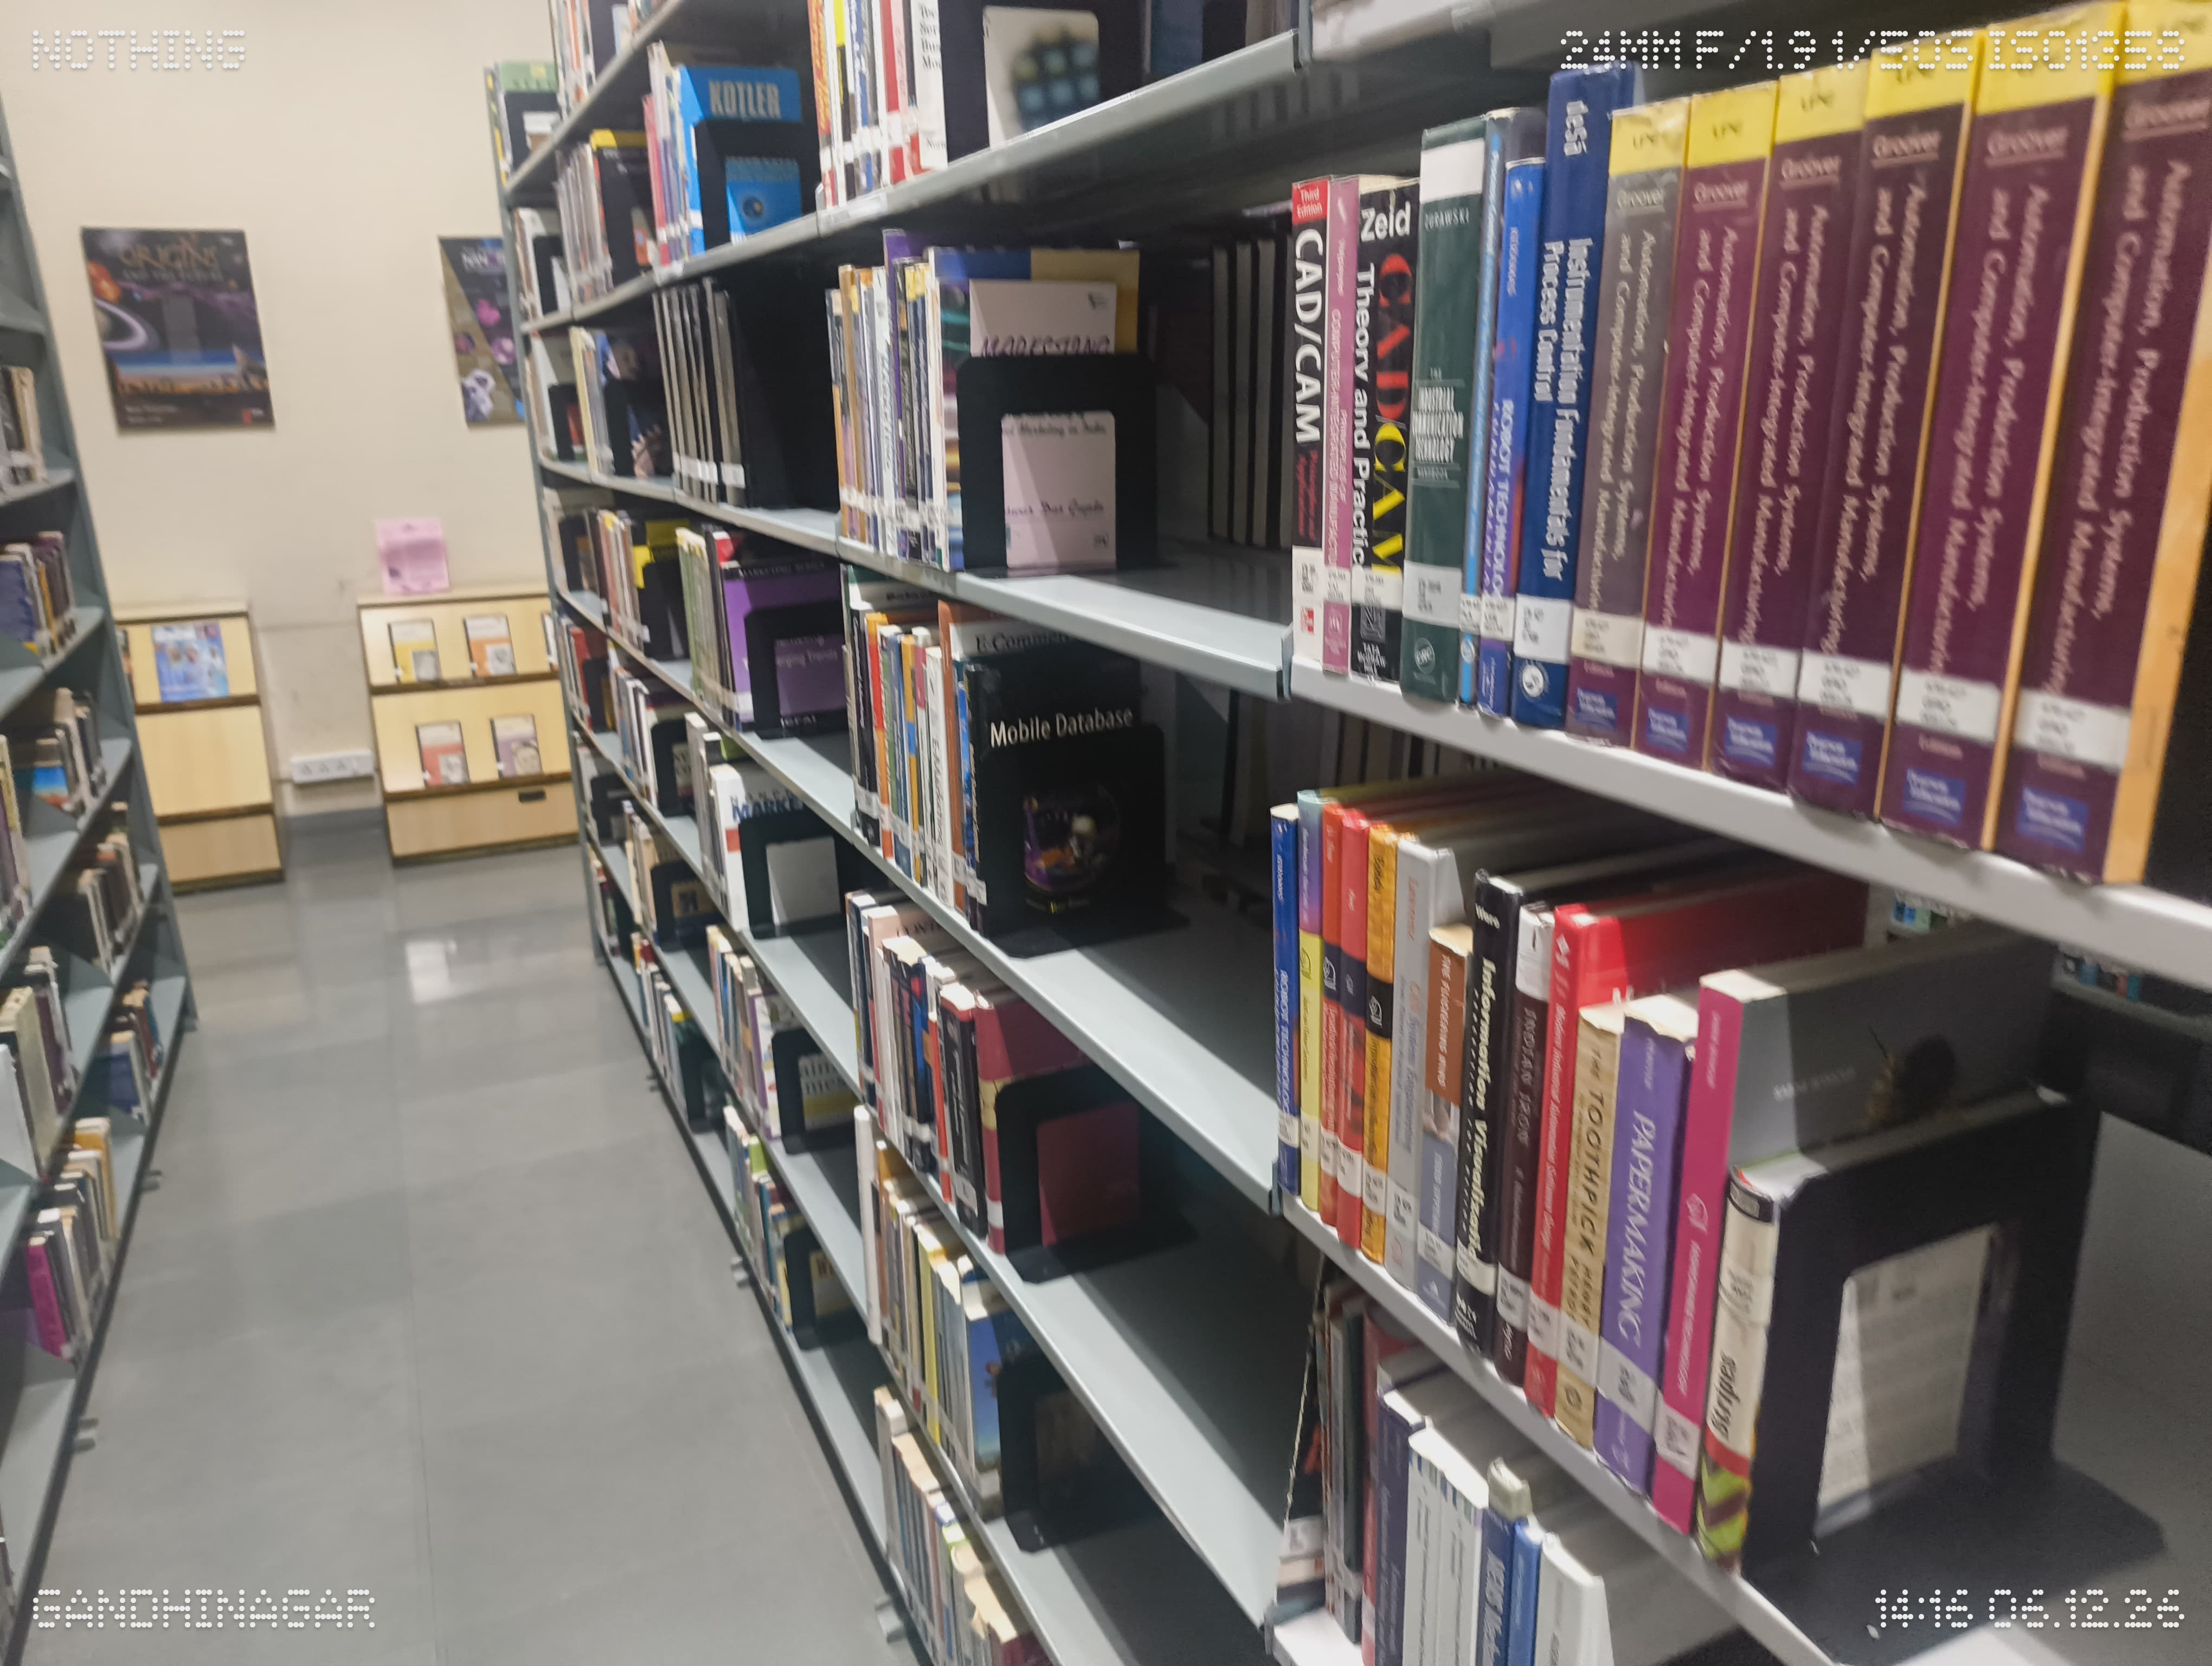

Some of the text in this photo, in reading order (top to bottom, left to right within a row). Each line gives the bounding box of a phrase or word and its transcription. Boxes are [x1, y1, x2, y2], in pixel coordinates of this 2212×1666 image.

[709, 82, 781, 120] KOTLER
[1296, 202, 1323, 219] Edition
[1301, 184, 1320, 204] Third
[1874, 188, 1894, 235] and
[1989, 187, 2010, 240] and
[2123, 165, 2147, 221] and
[1619, 232, 1634, 273] and
[1697, 229, 1713, 271] and
[1783, 208, 1800, 254] and
[1294, 228, 1323, 444] CAD/CAM
[1534, 240, 1565, 402] Process Control
[1352, 262, 1375, 566] Theory and Practic
[1498, 399, 1514, 475] ROBOT
[1541, 237, 1593, 582] Instrumentation Fundamentals for
[1328, 480, 1339, 566] MANUFACTU
[1491, 478, 1509, 595] TECHNOLO
[990, 706, 1133, 748] Mobile Database
[1279, 969, 1289, 1021] ROBOT
[1437, 954, 1451, 1087] THE FLICKERING MIND
[1554, 1002, 1566, 1051] Modern
[1550, 1047, 1564, 1104] Industrial
[1467, 957, 1496, 1258] Information Visualizatio
[1578, 1089, 1605, 1256] TOOTHPICK
[1617, 1109, 1656, 1349] PAPERMAKING
